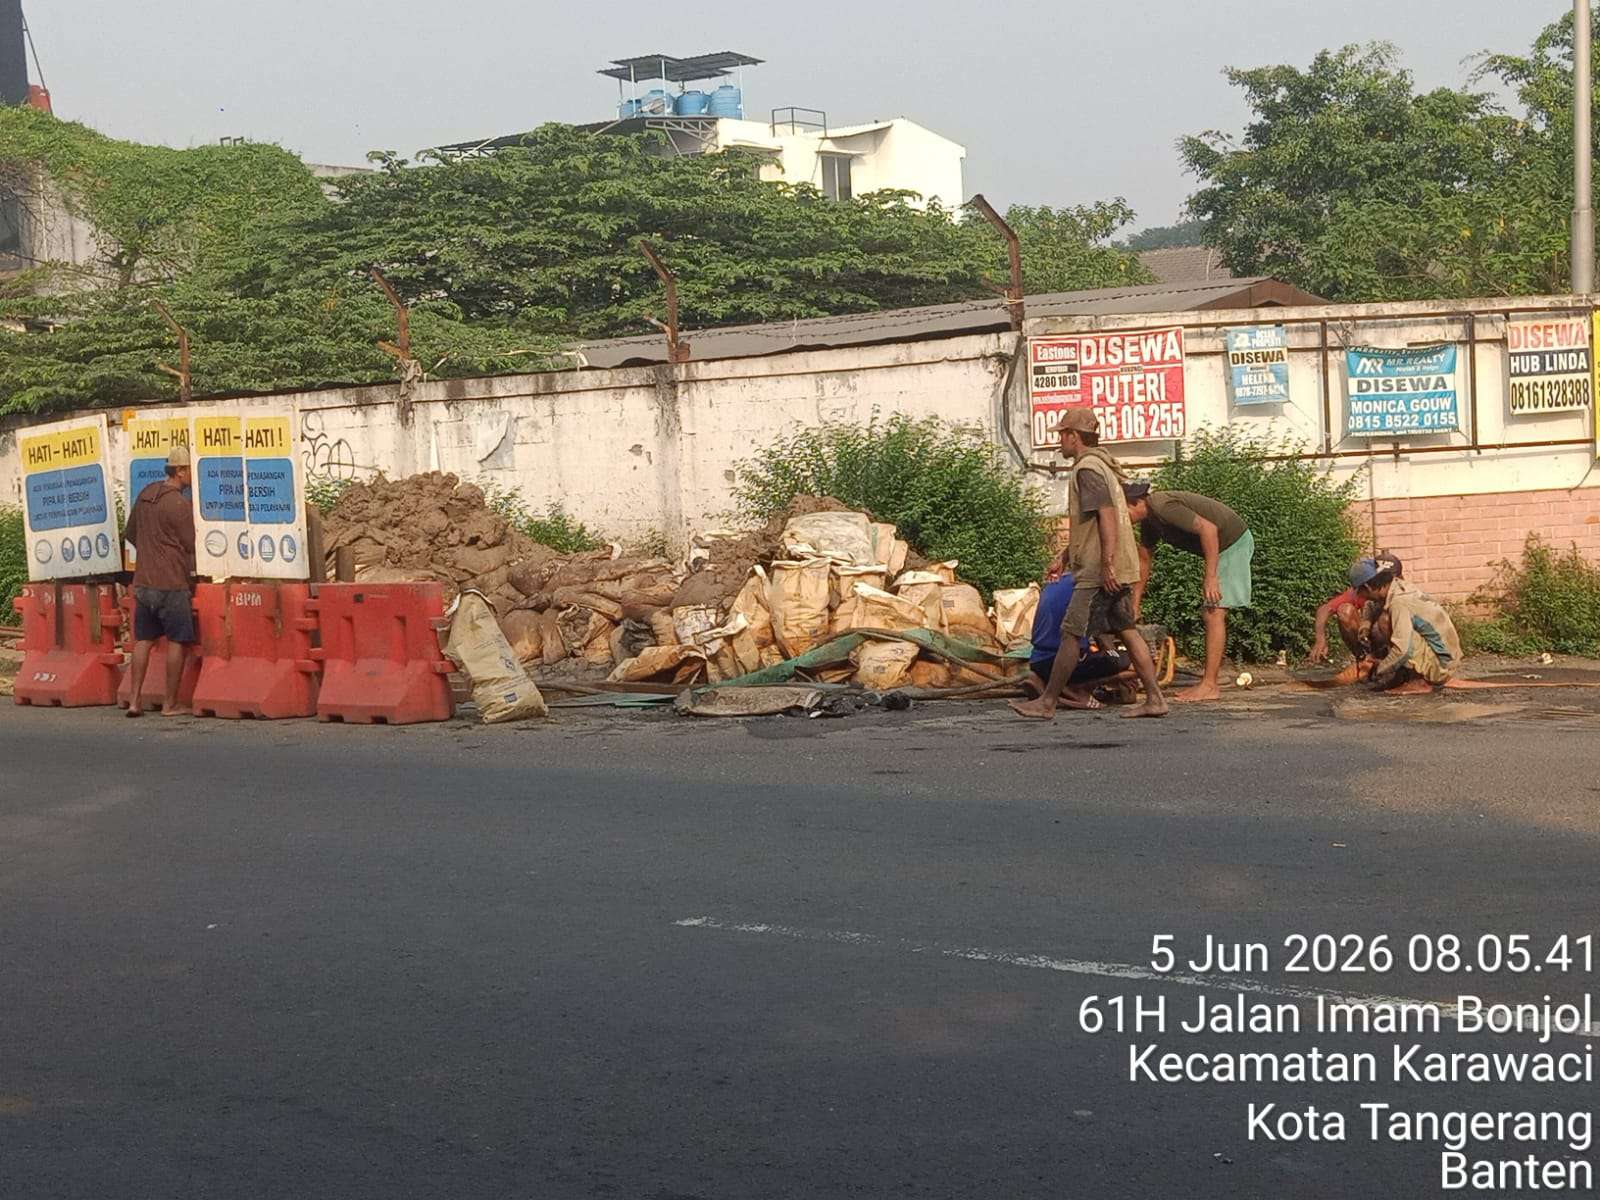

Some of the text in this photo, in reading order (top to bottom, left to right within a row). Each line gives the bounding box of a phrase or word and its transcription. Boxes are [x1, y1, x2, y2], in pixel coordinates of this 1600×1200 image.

[1509, 321, 1587, 350] DISEWA
[1037, 344, 1077, 360] Eastons
[1081, 331, 1182, 367] DISEWA
[1231, 350, 1286, 365] DISEWA
[1510, 352, 1588, 374] HUB LINDA
[1034, 375, 1057, 389] 4280
[1091, 372, 1166, 405] PUTERI
[1356, 376, 1448, 393] DISEWA
[1511, 378, 1590, 410] 08161328388
[1351, 397, 1453, 414] MONICA GOUW
[1121, 404, 1146, 440] 06
[1149, 402, 1184, 438] 255
[1348, 411, 1456, 429] 0815 8522 0155
[249, 486, 276, 498] BERSIH
